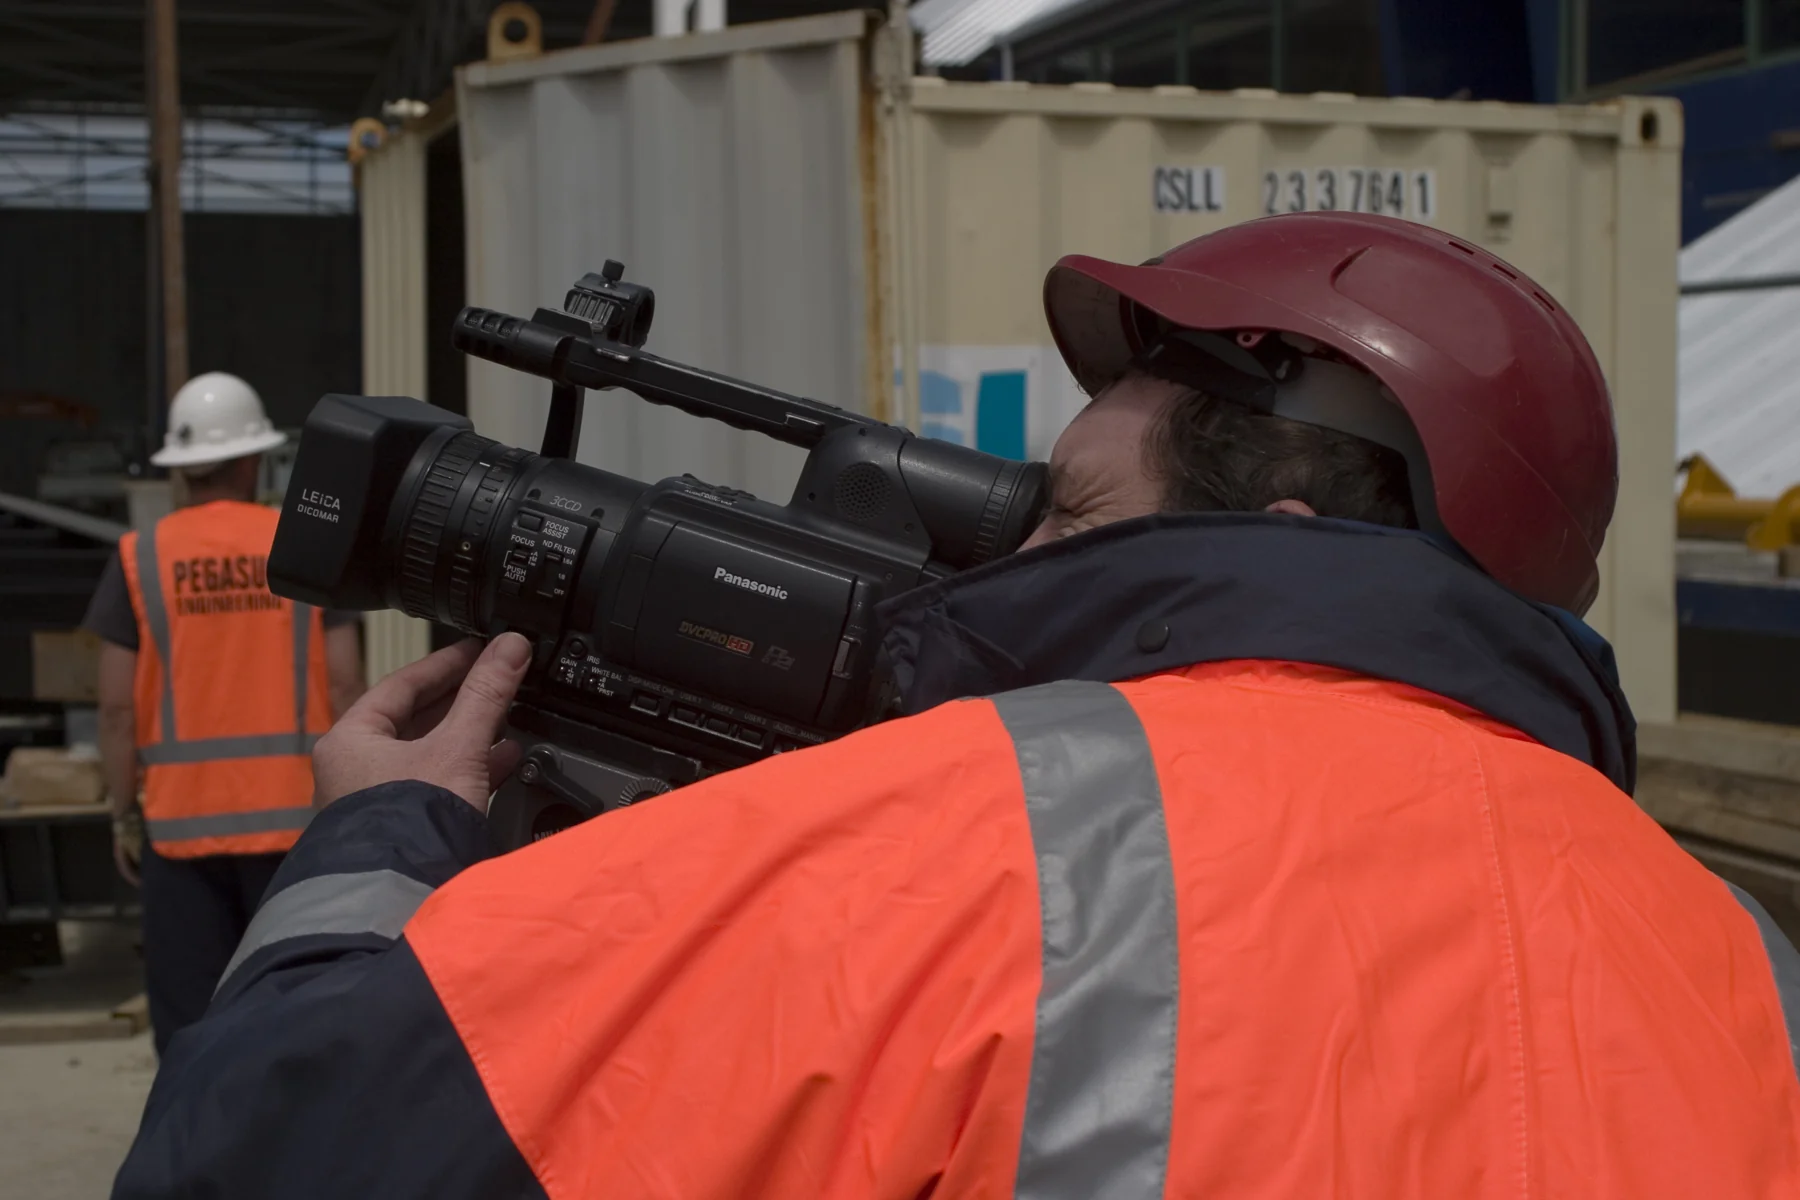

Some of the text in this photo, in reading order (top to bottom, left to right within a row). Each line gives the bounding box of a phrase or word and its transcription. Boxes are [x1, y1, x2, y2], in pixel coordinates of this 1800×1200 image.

[1153, 166, 1222, 213] CSLL
[549, 495, 582, 512] 3CCD
[297, 503, 339, 524] DICOMAR
[542, 527, 567, 540] ASSIST
[545, 520, 570, 534] FOCUS
[510, 534, 536, 548] FOCUS
[542, 540, 577, 556] ND FILTER
[506, 564, 527, 577] PUSH
[504, 571, 526, 584] AUTO
[714, 566, 788, 600] Panasonic
[553, 588, 565, 596] OFF
[560, 657, 578, 668] GAIN
[586, 655, 600, 665] IRIS
[591, 666, 611, 678] WHITE
